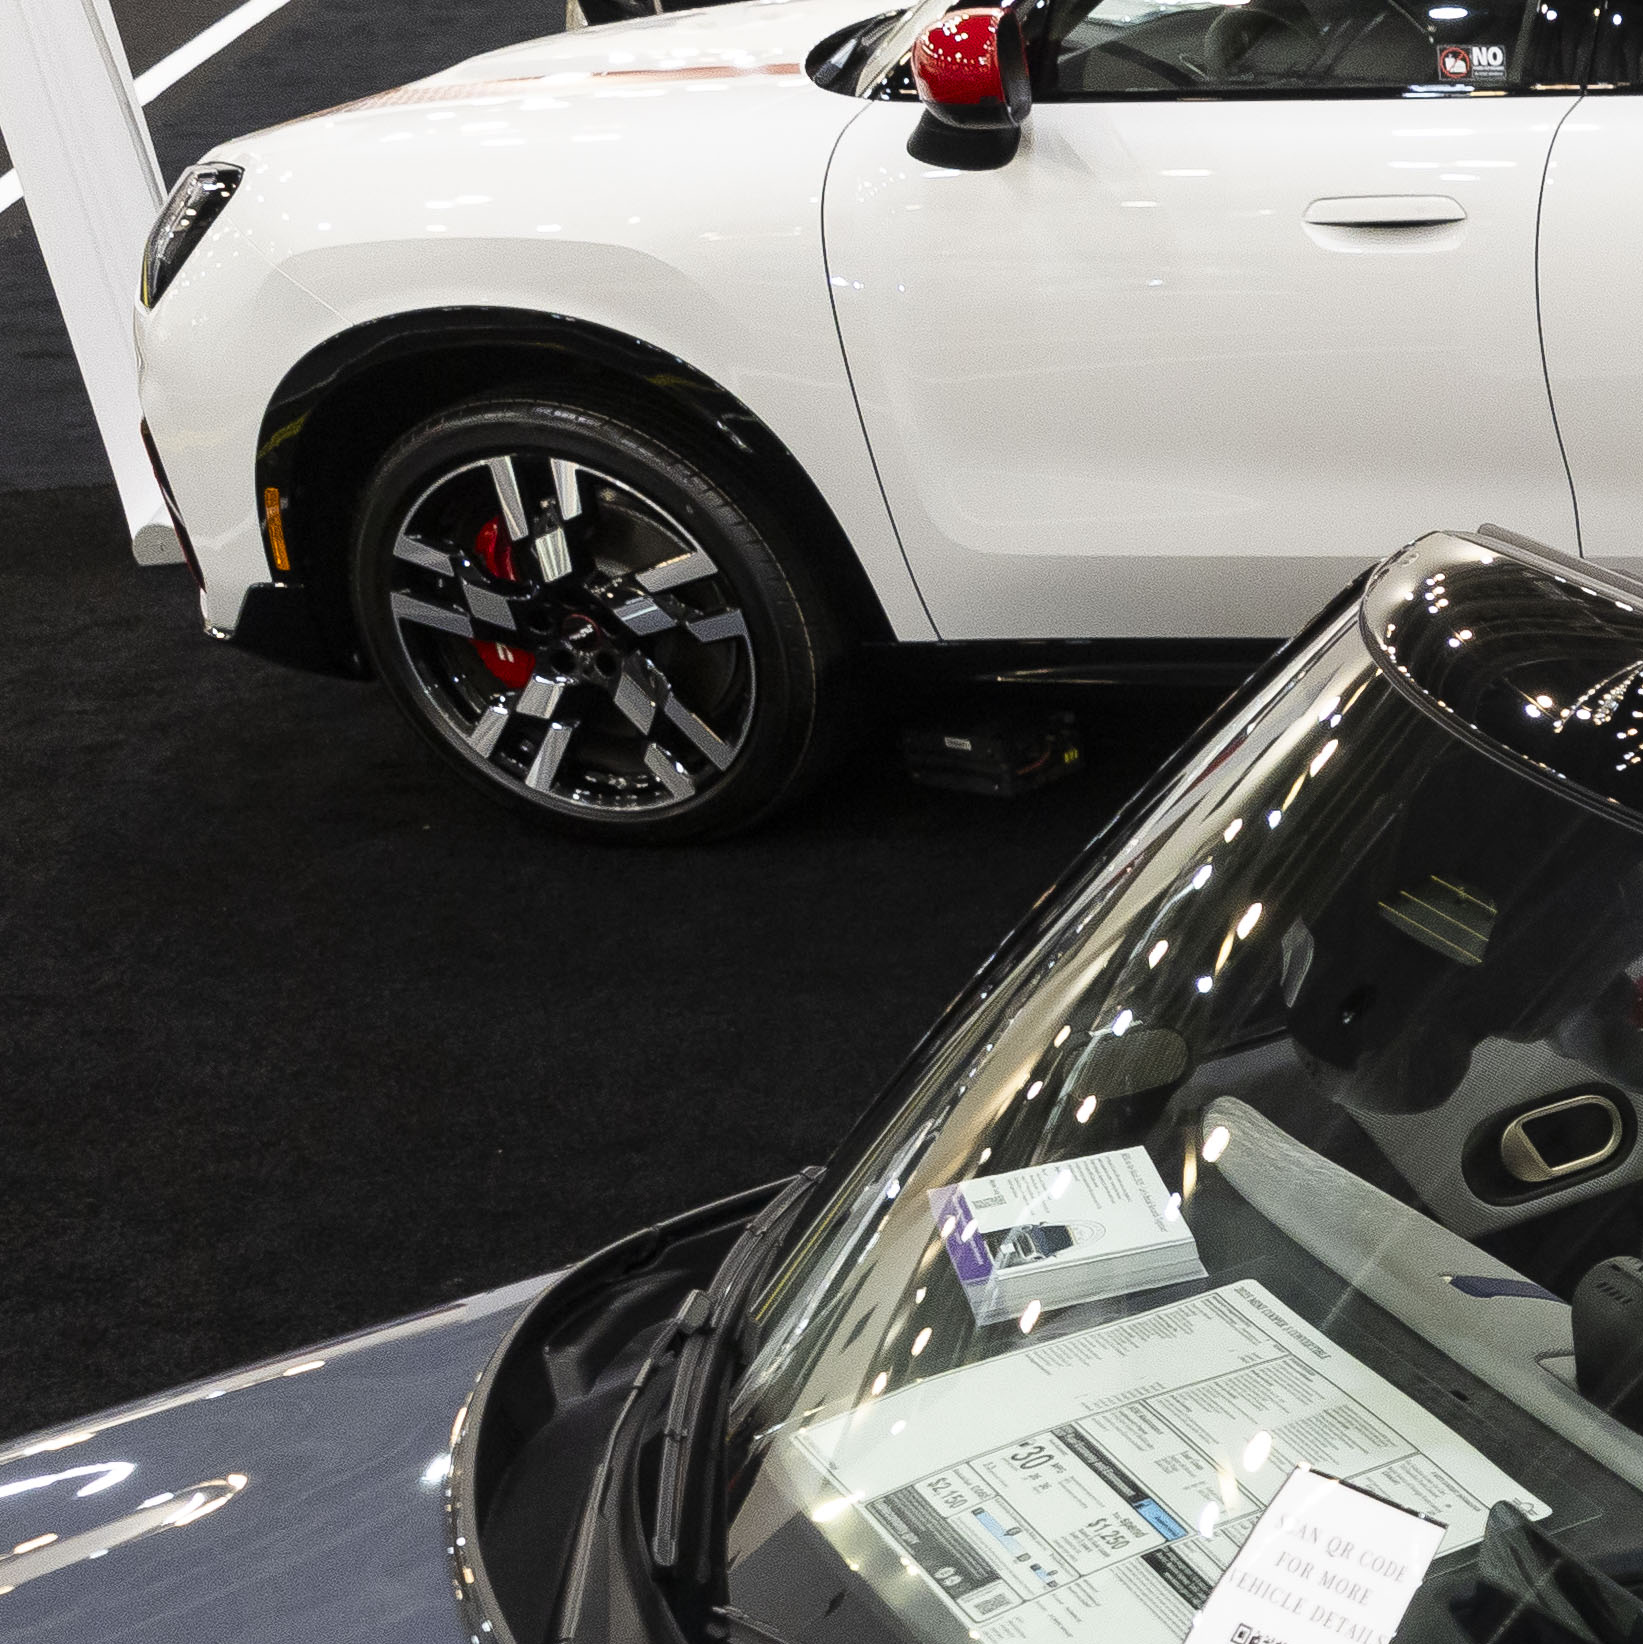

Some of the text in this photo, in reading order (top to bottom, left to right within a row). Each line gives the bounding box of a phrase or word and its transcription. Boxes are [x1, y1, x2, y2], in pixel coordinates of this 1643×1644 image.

[1472, 46, 1503, 66] NO
[1259, 1307, 1291, 1328] COOPER
[1007, 1443, 1058, 1472] 30
[926, 1475, 969, 1511] $2,150
[1086, 1516, 1131, 1553] $1,250
[1115, 1515, 1150, 1540] spend
[1326, 1535, 1355, 1559] QR
[1359, 1549, 1409, 1583] CODE
[1274, 1551, 1374, 1607] FOR MORE
